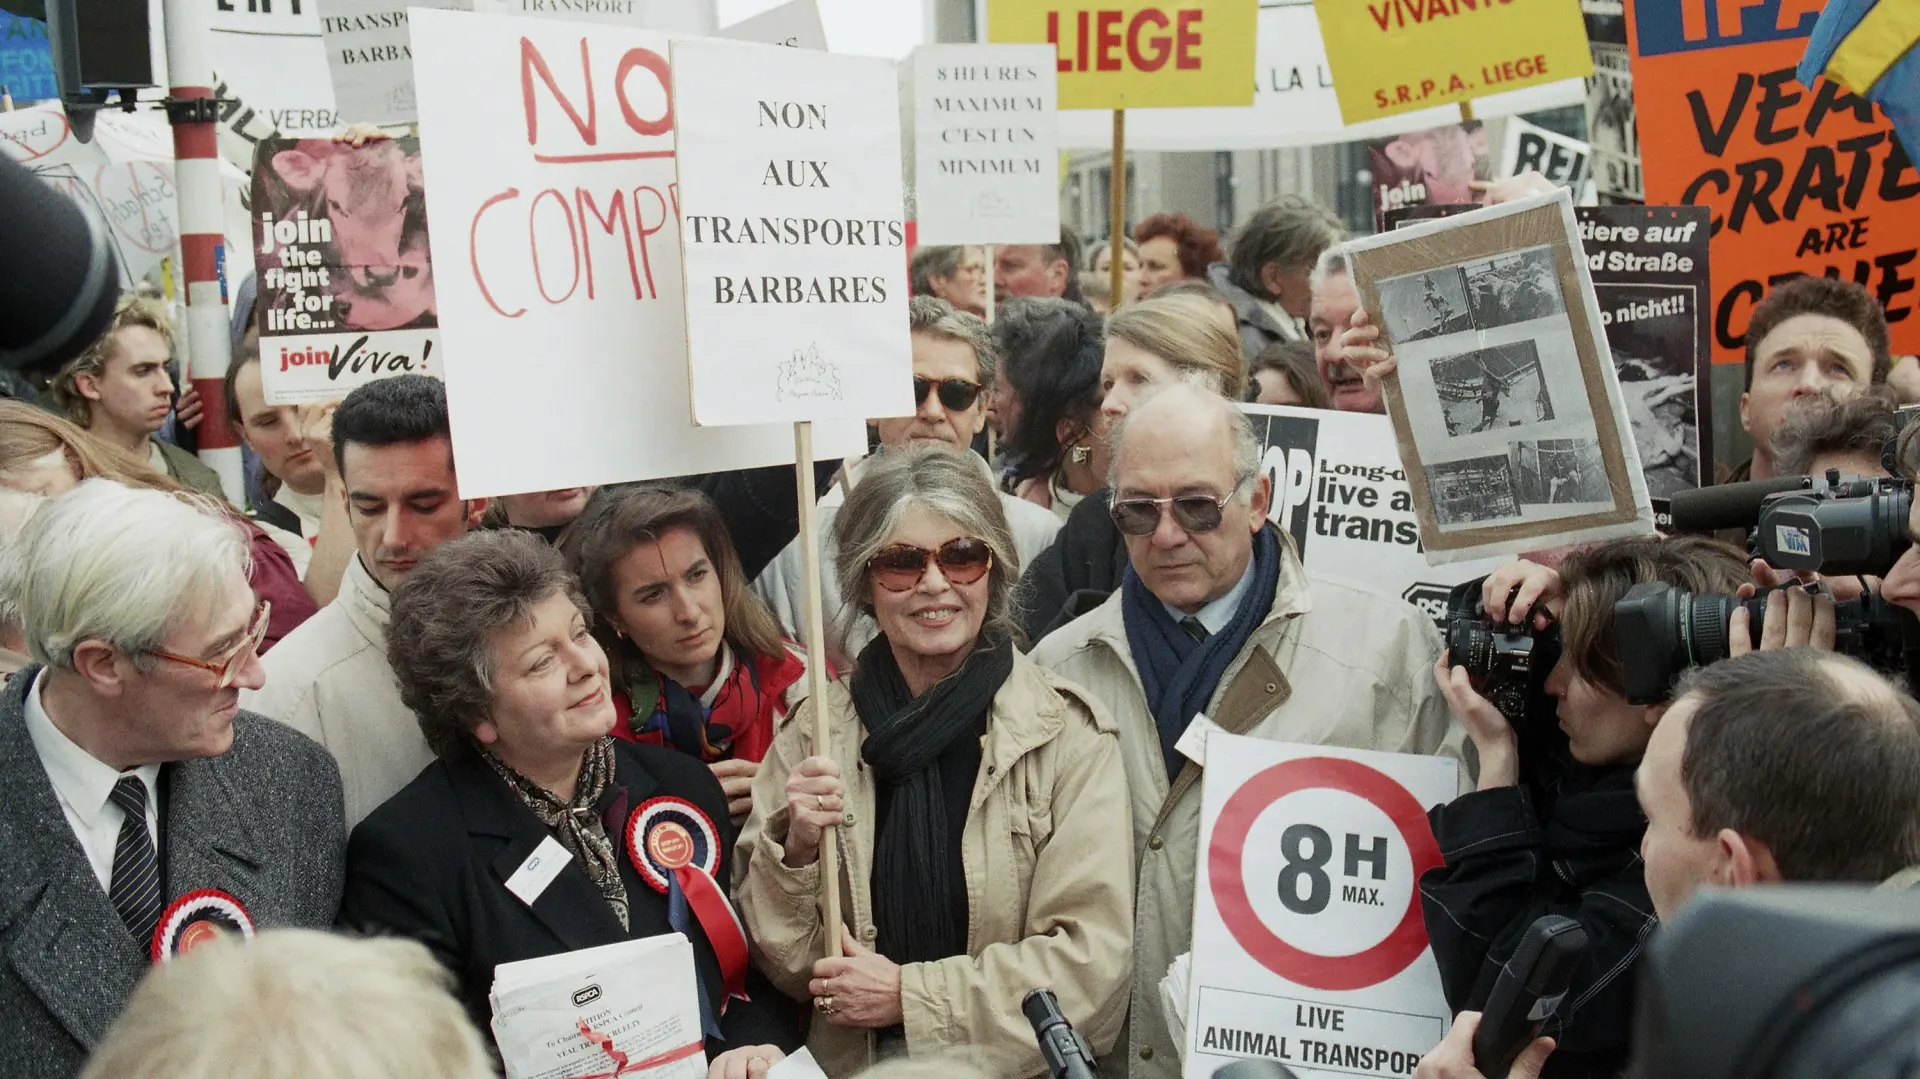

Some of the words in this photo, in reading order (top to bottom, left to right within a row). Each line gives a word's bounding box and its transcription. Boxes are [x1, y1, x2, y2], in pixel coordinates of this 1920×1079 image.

[322, 12, 408, 33] TRANSP
[1368, 0, 1514, 32] VIVA
[1047, 8, 1203, 73] LIEGE
[937, 67, 947, 81] 8
[954, 66, 1037, 81] HEURES
[1482, 54, 1550, 86] LIEGE
[519, 36, 673, 146] NO
[934, 97, 1042, 112] MAXIMUM
[757, 100, 828, 130] NON
[1686, 62, 1887, 158] VEA
[942, 128, 1000, 142] C'EST
[1007, 128, 1036, 142] UN
[762, 159, 830, 188] AUX
[939, 159, 1041, 174] MINIMUM
[1379, 179, 1427, 211] join
[261, 211, 332, 254] join
[686, 215, 903, 248] TRANSPORTS
[1643, 221, 1698, 243] auf
[1796, 216, 1870, 258] ARE
[278, 246, 322, 267] the
[470, 183, 679, 318] COMP
[1607, 251, 1694, 273] Straße
[264, 267, 331, 293] fight
[713, 275, 888, 305] BARBARES
[293, 290, 333, 313] for
[1616, 294, 1686, 323] nicht!!
[267, 308, 335, 331] life...
[280, 346, 331, 372] join
[327, 336, 433, 381] Viva!
[1258, 445, 1313, 533] OP
[1316, 475, 1379, 508] live
[1390, 490, 1415, 512] a
[1276, 823, 1333, 915] 8
[1342, 833, 1388, 880] H
[1341, 884, 1385, 907] MAX.
[576, 988, 599, 1004] RSPCA
[1294, 1004, 1345, 1032] LIVE
[1203, 1025, 1292, 1060] ANIMAL
[1300, 1039, 1425, 1076] TRANSPOR
